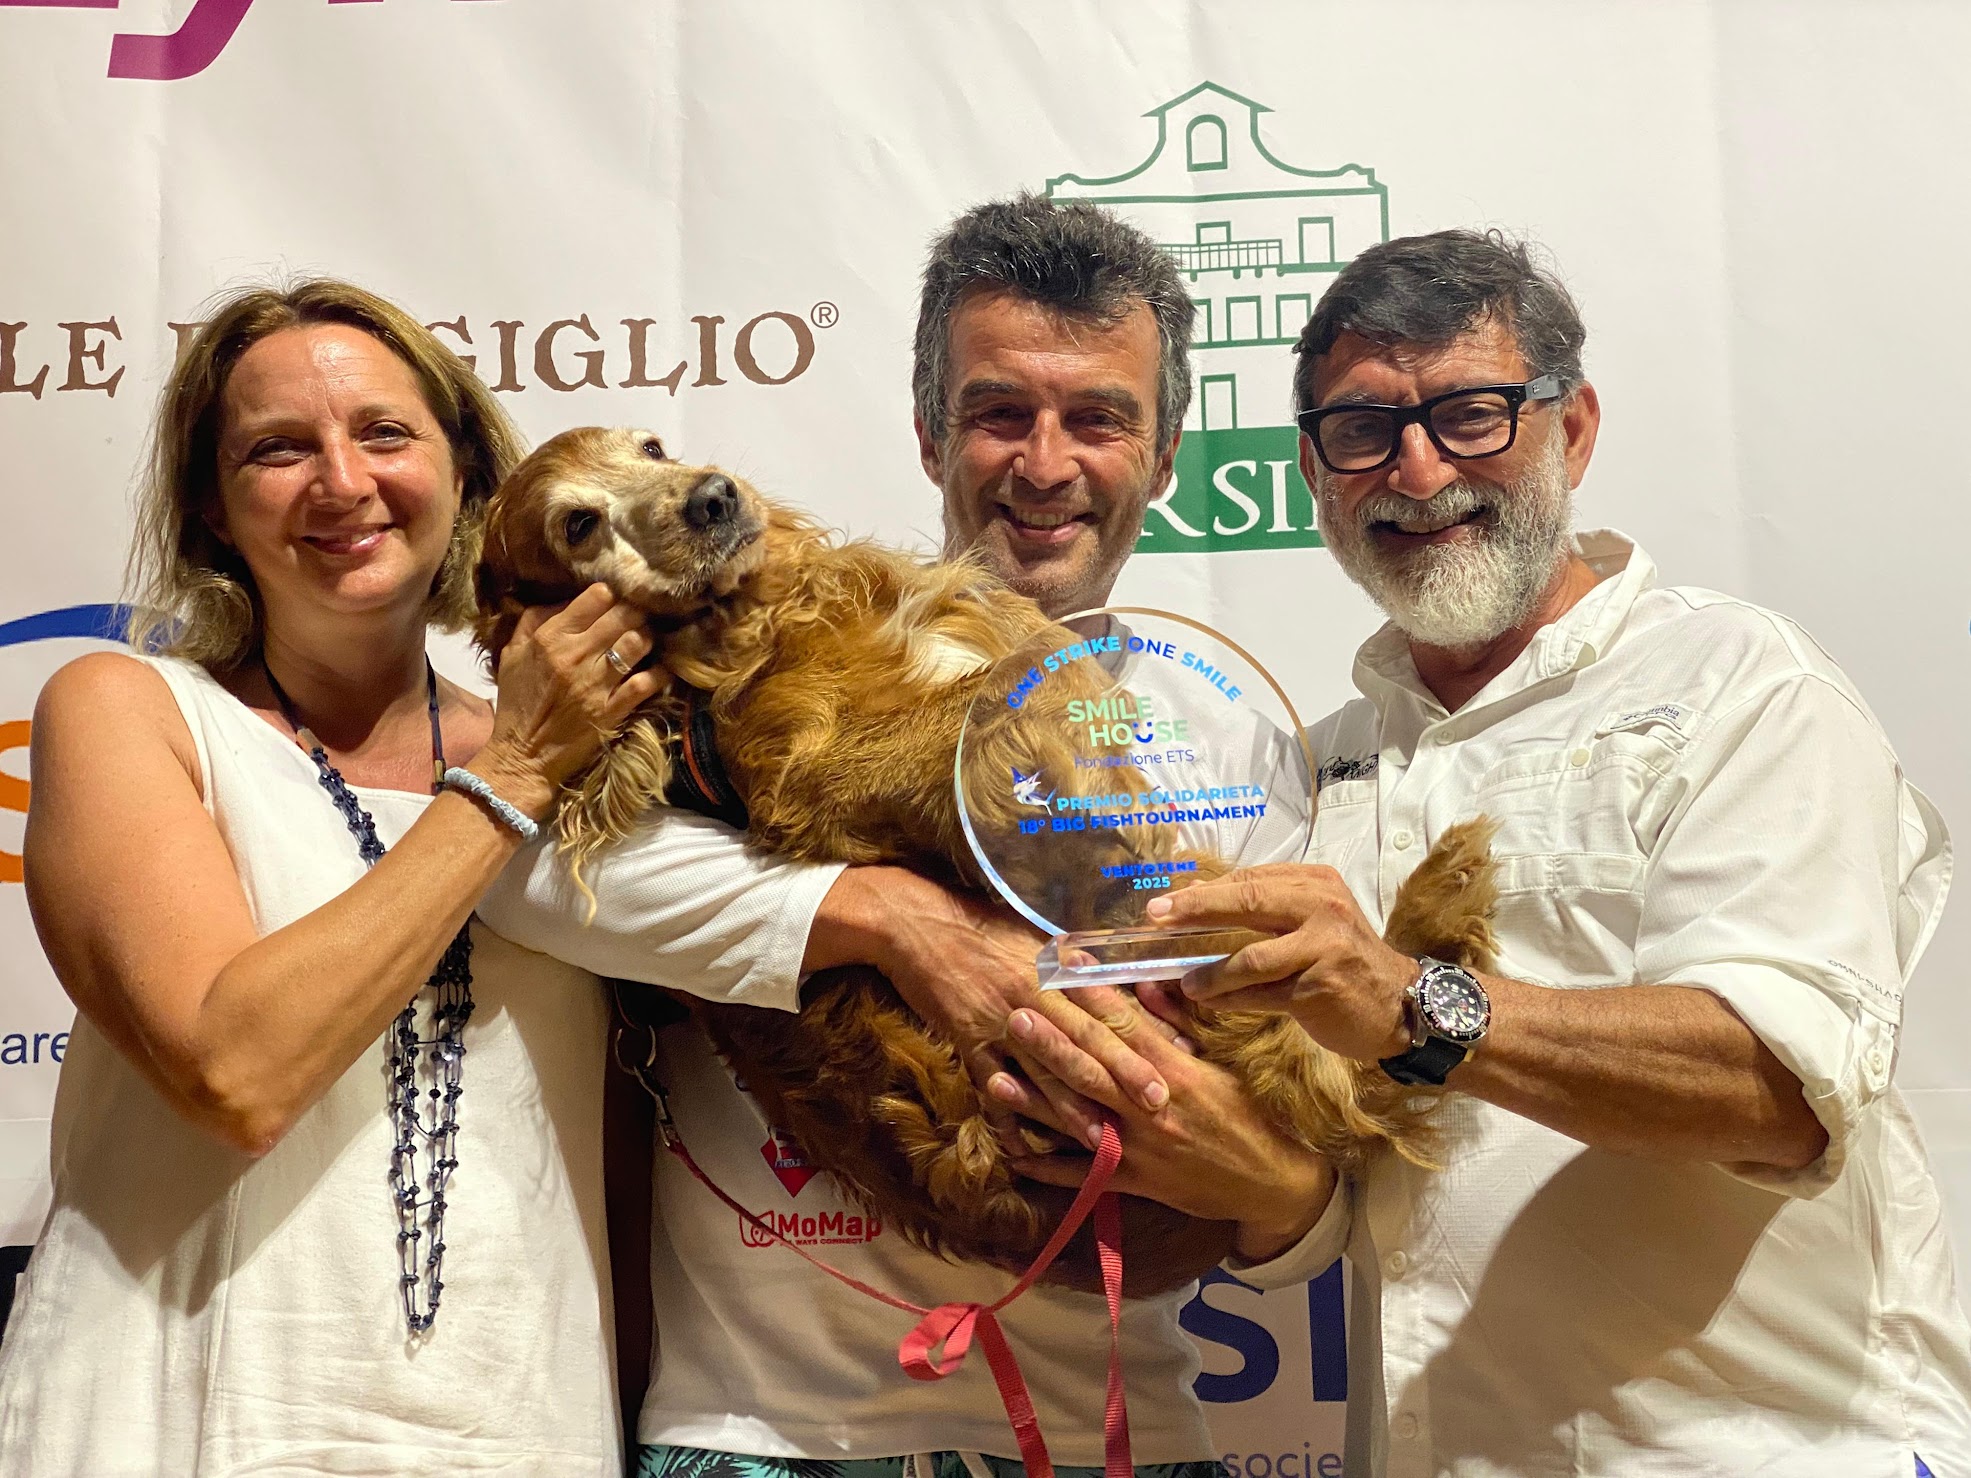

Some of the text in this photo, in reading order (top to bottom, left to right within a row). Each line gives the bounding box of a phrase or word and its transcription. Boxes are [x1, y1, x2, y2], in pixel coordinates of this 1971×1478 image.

[1006, 636, 1243, 710] ONE STRIKE ONE SMILE
[1067, 696, 1154, 723] SMILE
[1075, 749, 1195, 769] Fondazione ETS
[1056, 784, 1265, 812] PREMIO SOLIDARIETA
[1052, 816, 1086, 833] BIG
[1091, 804, 1267, 830] FISHTOURNAMENT
[1132, 876, 1172, 890] 2025
[778, 1211, 882, 1242] MoMap
